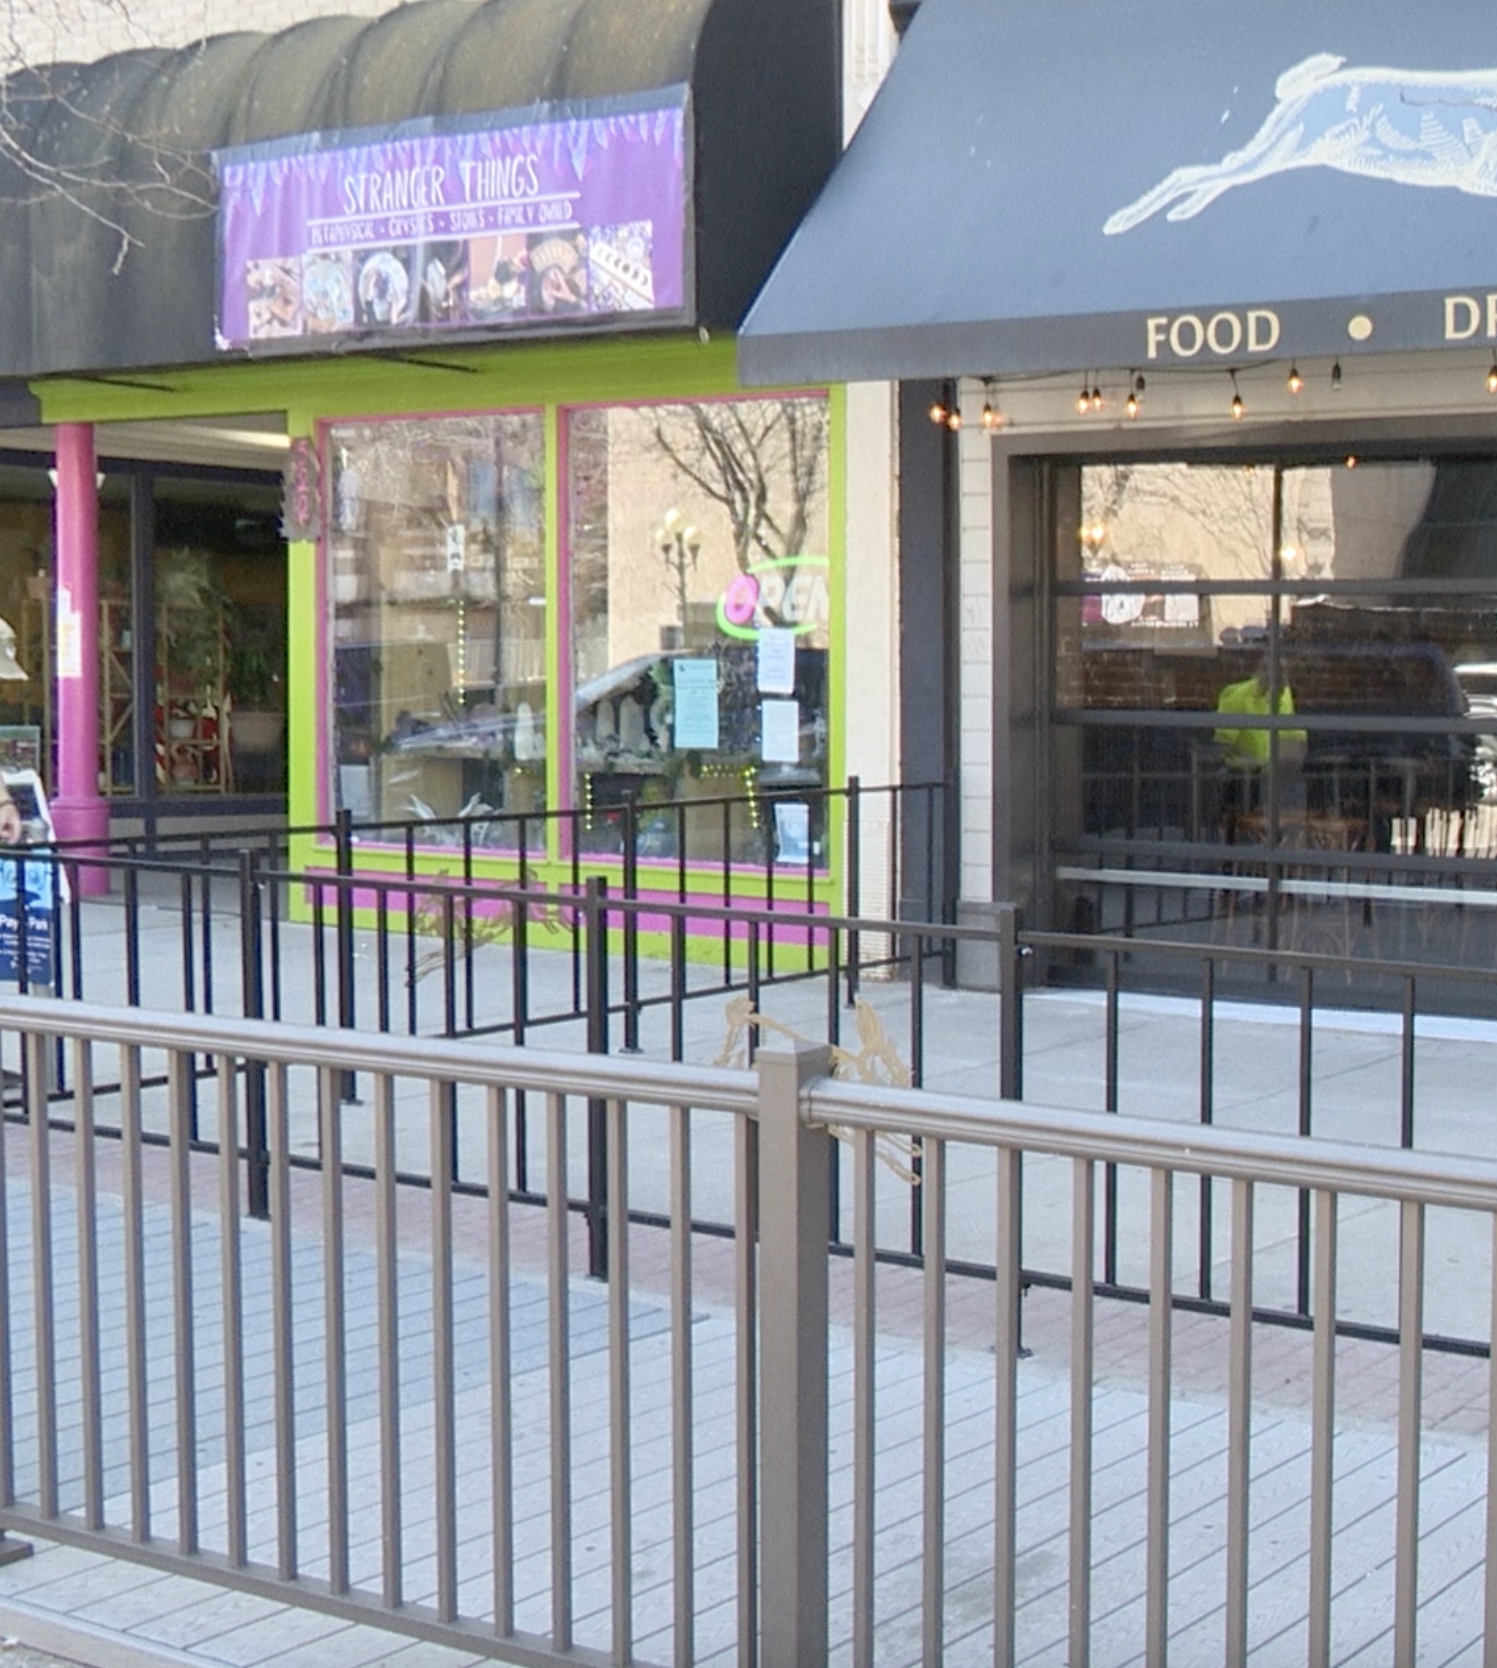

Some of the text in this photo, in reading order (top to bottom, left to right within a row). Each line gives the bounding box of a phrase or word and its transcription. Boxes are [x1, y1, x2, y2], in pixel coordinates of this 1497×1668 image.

[343, 154, 539, 215] STRANGER THINGS
[538, 200, 573, 222] OWNED
[1146, 309, 1281, 359] FOOD
